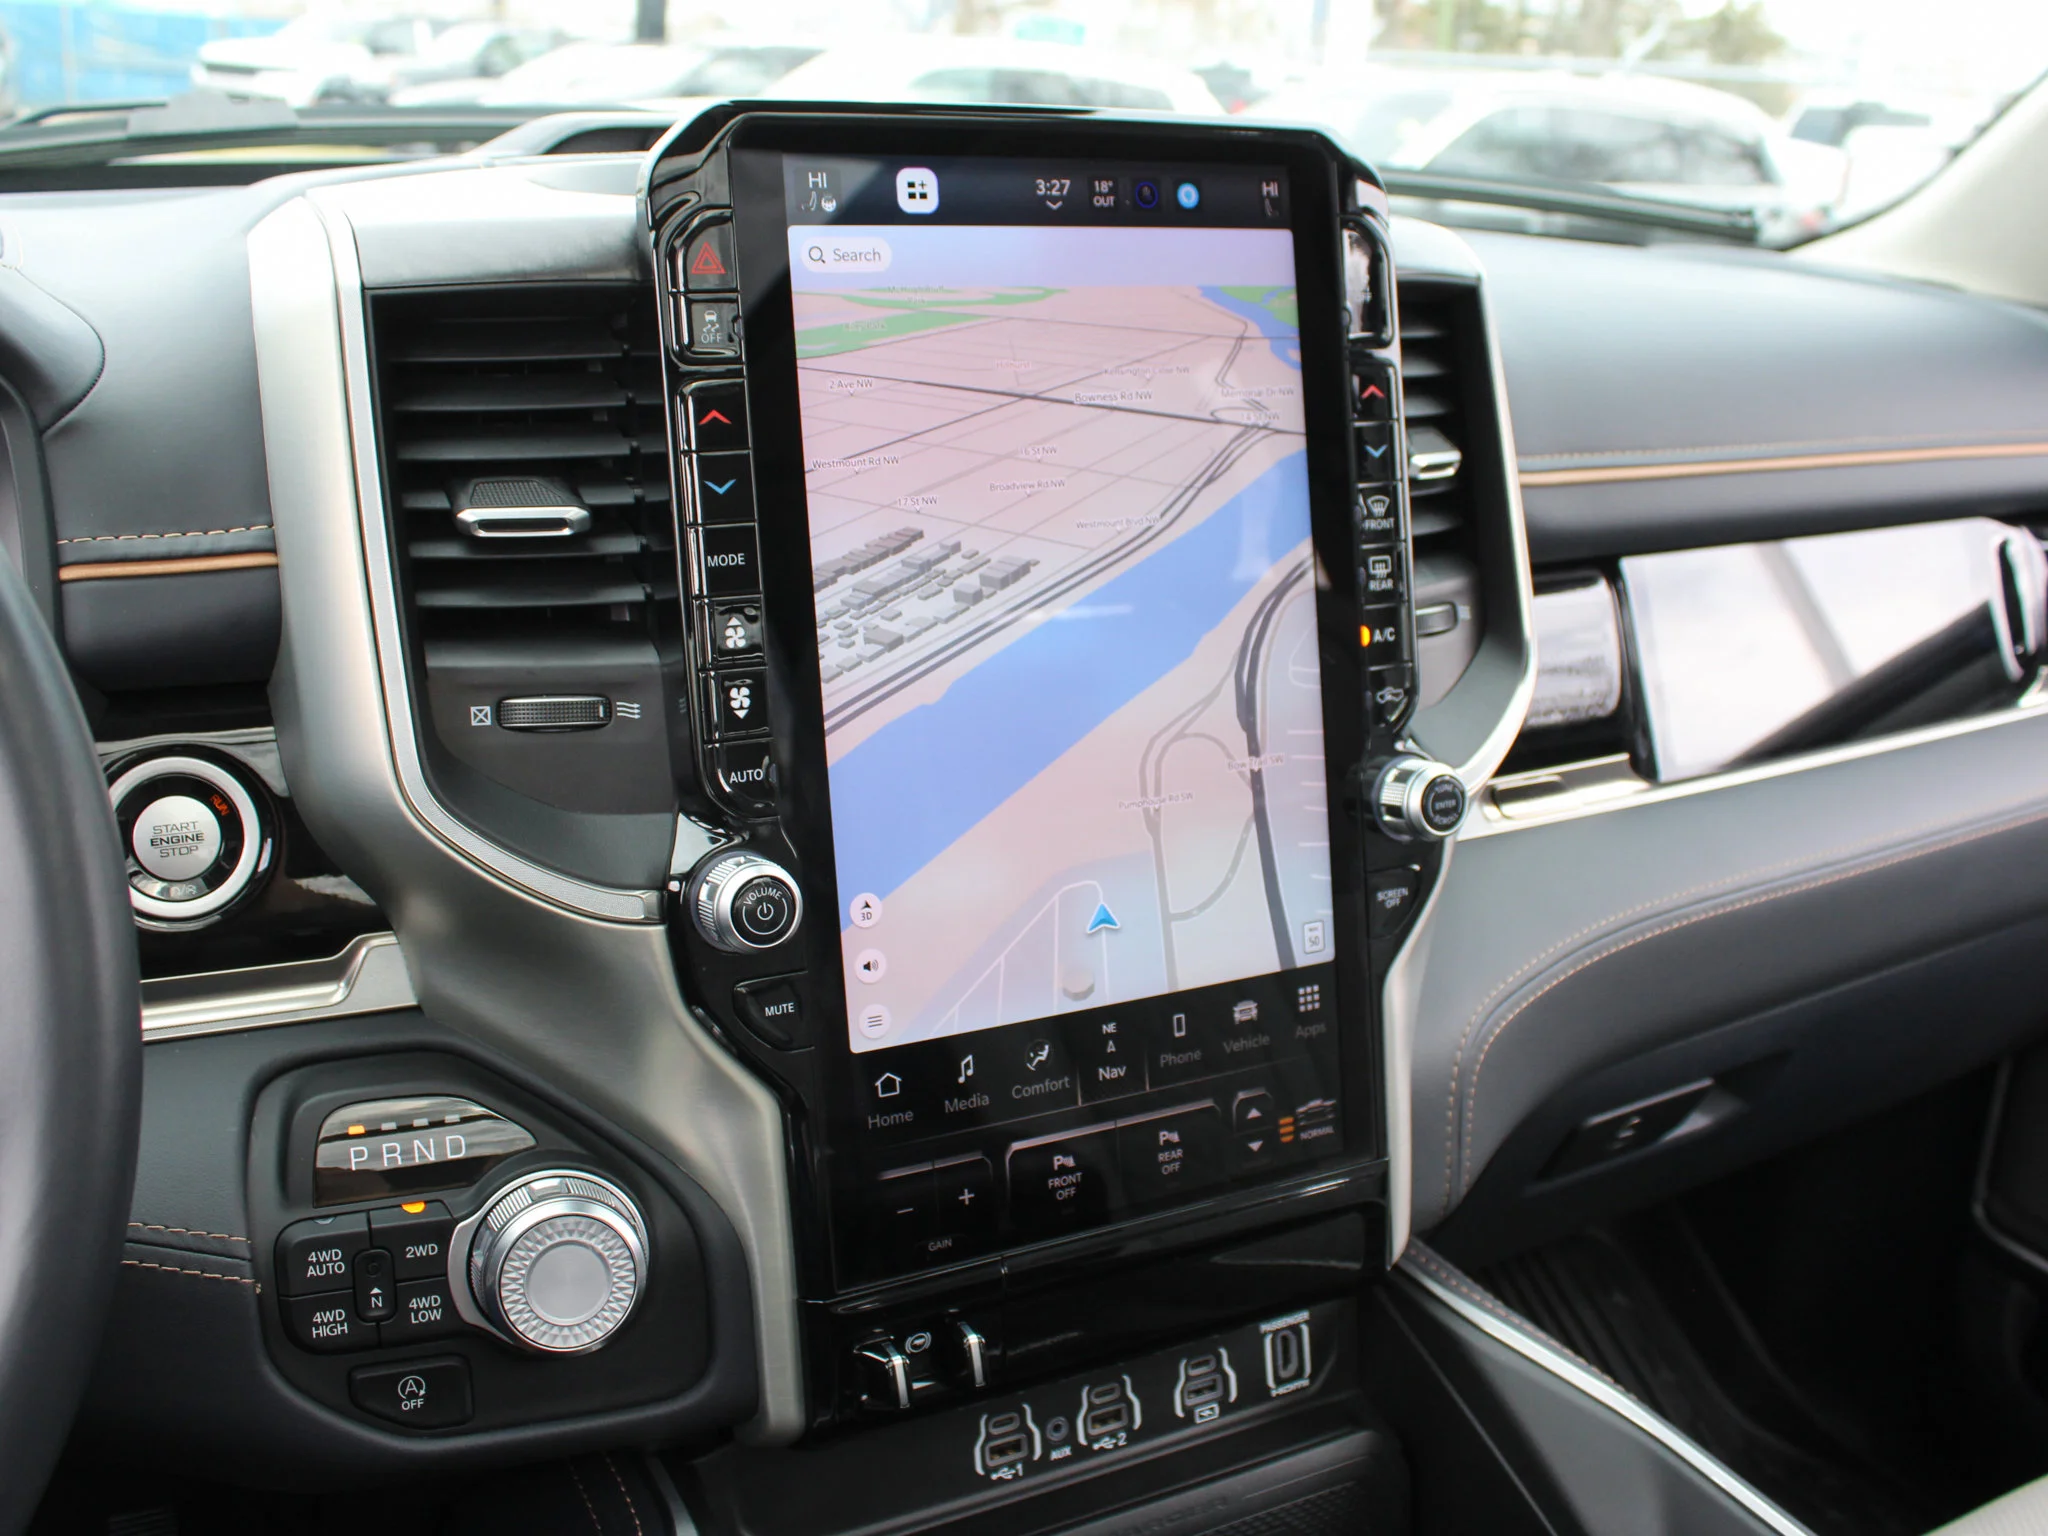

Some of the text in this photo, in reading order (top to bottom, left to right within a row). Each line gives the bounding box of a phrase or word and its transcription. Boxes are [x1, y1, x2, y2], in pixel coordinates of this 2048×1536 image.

[808, 171, 828, 189] HI
[1036, 179, 1071, 197] 3:27
[1261, 181, 1279, 198] HI
[1093, 195, 1115, 207] OUT
[832, 248, 882, 263] Search
[700, 332, 723, 344] OFF
[838, 379, 855, 390] Ave
[856, 378, 874, 389] NW
[1075, 390, 1153, 402] Bowness Rd NW
[1041, 445, 1058, 455] NW
[812, 455, 900, 470] Westmount Rd NW
[989, 479, 1067, 493] Broadview Rd NW
[911, 497, 920, 506] St
[921, 496, 938, 506] NW
[1076, 518, 1123, 530] Westmount
[1144, 515, 1161, 526] NW
[1365, 517, 1395, 531] FRONT
[707, 553, 746, 568] MODE
[1368, 578, 1394, 592] REAR
[1372, 628, 1396, 642] A/C
[729, 768, 764, 784] AUTO
[209, 793, 231, 817] RUN
[152, 820, 200, 835] START
[150, 832, 205, 847] ENGINE
[159, 845, 199, 859] STOP
[743, 886, 783, 906] VOLUME
[1376, 887, 1409, 902] SCREEN
[860, 911, 873, 922] 3D
[765, 1002, 796, 1017] MUTE
[1102, 1022, 1118, 1035] NE
[1295, 1021, 1327, 1039] Apps
[1223, 1034, 1271, 1054] Vehicle
[1159, 1049, 1202, 1068] Phone
[1098, 1065, 1127, 1081] Nav
[1011, 1075, 1071, 1100] Comfort
[944, 1092, 991, 1114] Media
[867, 1109, 914, 1130] Home
[350, 1134, 467, 1172] P R N D
[1158, 1149, 1184, 1164] REAR
[1161, 1161, 1181, 1176] OFF
[1048, 1172, 1083, 1190] FRONT
[1056, 1187, 1077, 1201] OFF
[405, 1243, 439, 1260] 2WD
[928, 1238, 953, 1253] GAIN
[307, 1248, 342, 1264] 4WD
[306, 1261, 346, 1278] AUTO
[371, 1295, 383, 1309] N
[408, 1294, 442, 1310] 4WD
[312, 1308, 346, 1325] 4WD
[410, 1308, 443, 1325] LOW
[311, 1321, 349, 1339] HIGH
[401, 1398, 425, 1411] OFF
[1117, 1431, 1128, 1447] 2
[1050, 1445, 1073, 1461] AUX
